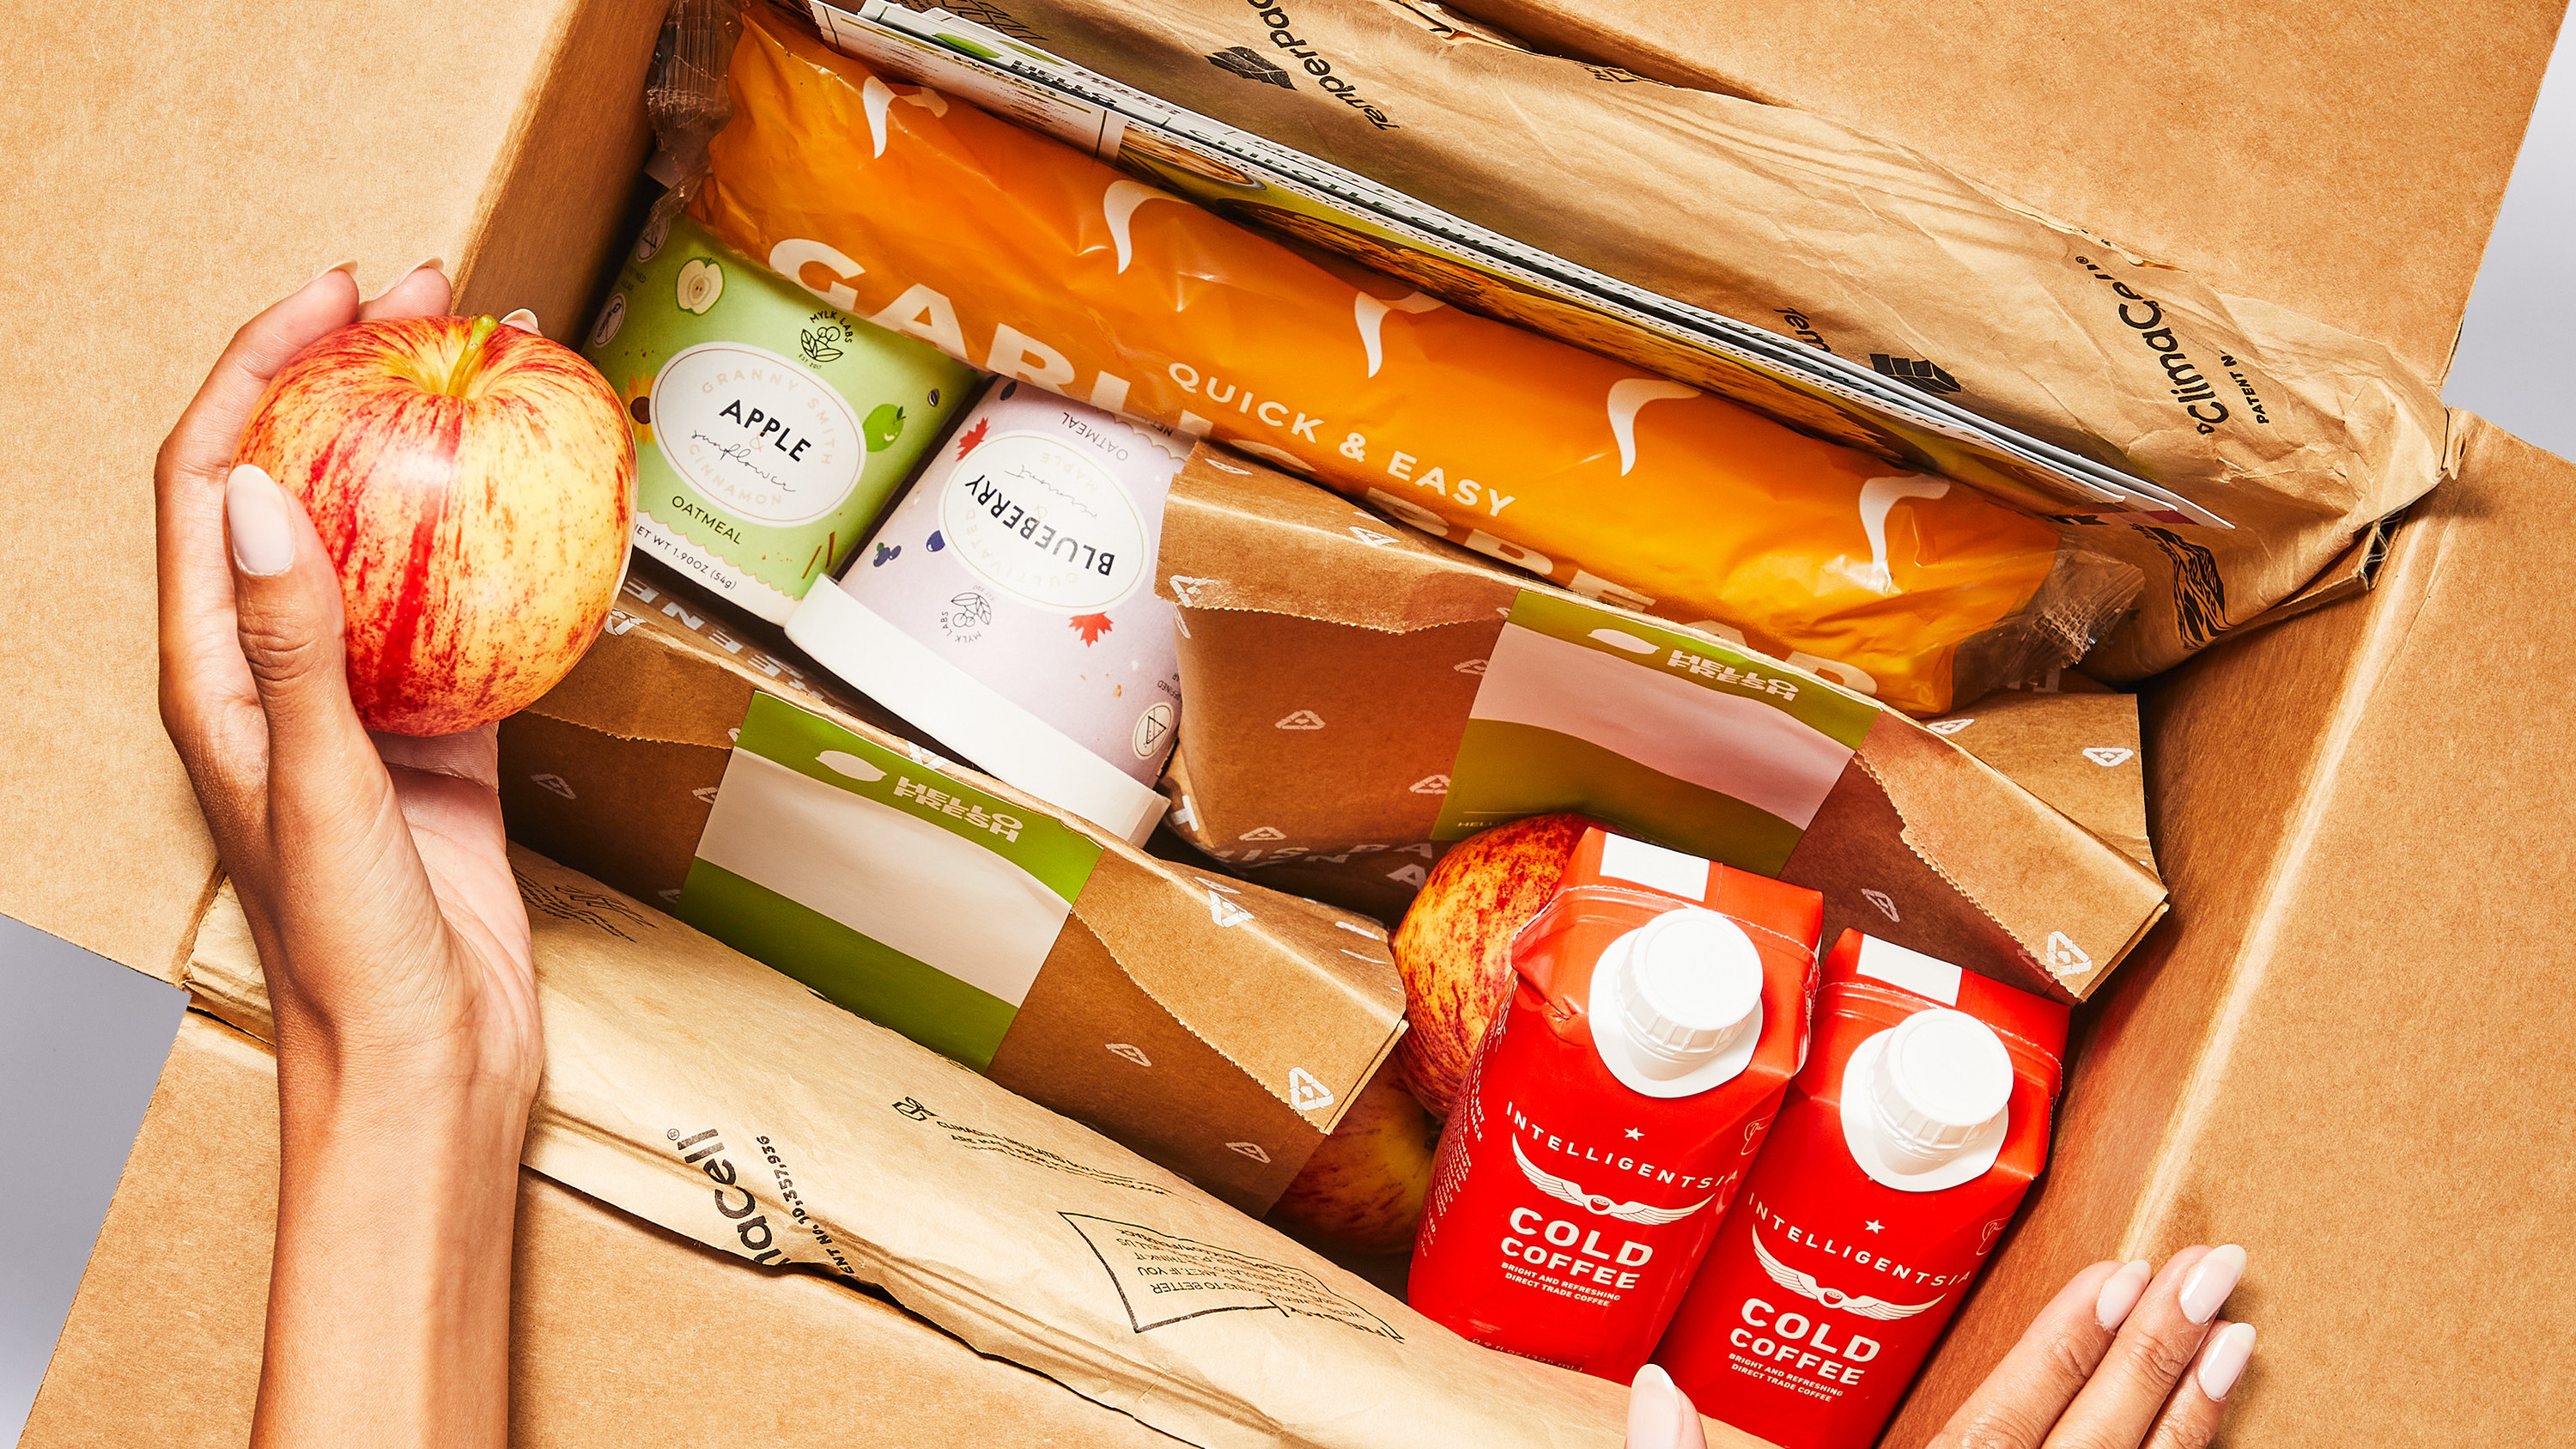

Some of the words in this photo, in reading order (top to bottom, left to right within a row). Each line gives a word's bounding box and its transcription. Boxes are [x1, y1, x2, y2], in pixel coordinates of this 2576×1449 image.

[1010, 58, 1118, 106] HELLO
[1189, 128, 1395, 212] CHIPOTLE
[1409, 213, 1600, 290] CHICKEN
[1253, 139, 1361, 183] MISO
[1375, 187, 1517, 249] PEACH
[1127, 120, 1394, 226] MEATLOAVES
[1407, 228, 1512, 269] WITH
[1706, 338, 1947, 429] MUSHROOM
[809, 310, 837, 324] MYLK
[839, 313, 854, 344] LABS
[702, 368, 799, 395] GRANNY
[806, 397, 832, 466] SMITH
[2233, 371, 2269, 426] PATENT
[719, 399, 812, 464] APPLE
[748, 429, 765, 452] &
[1061, 411, 1129, 462] OATMEAL
[1168, 362, 1326, 446] QUICK
[1337, 432, 1370, 465] &
[1386, 450, 1517, 521] EASY
[688, 442, 782, 506] CINNAMON
[690, 429, 796, 493] sunflower
[1040, 451, 1098, 496] MAPLE
[671, 495, 742, 545] OATMEAL
[964, 474, 1116, 577] BLUEBERRY
[966, 509, 1079, 585] CULTIVATED
[653, 533, 671, 551] WT
[710, 568, 738, 591] (54g)
[940, 610, 953, 638] LABS
[954, 630, 983, 643] MYLK
[1667, 657, 1796, 702] FRESH
[1671, 649, 1800, 695] HELLO
[893, 786, 1020, 843] FRESH
[897, 776, 1024, 830] HELLO
[1506, 1101, 1738, 1189] INTELLIGENTSIA
[1501, 1236, 1641, 1289] COFFEE
[1510, 1206, 1654, 1268] COLD
[1749, 1192, 1971, 1286] INTELLIGENTSIA
[1137, 1267, 1169, 1276] YOU
[1151, 1282, 1203, 1294] BETTER
[1204, 1282, 1225, 1291] TO
[1501, 1262, 1537, 1279] BRIGHT
[1538, 1272, 1559, 1285] AND
[1561, 1277, 1621, 1302] REFRESHING
[1504, 1272, 1540, 1289] DIRECT
[1541, 1282, 1572, 1298] TRADE
[1574, 1291, 1611, 1307] COFFEE
[1730, 1328, 1865, 1386] COFFEE
[1741, 1298, 1880, 1362] COLD
[1728, 1353, 1763, 1370] BRIGHT
[1765, 1366, 1784, 1377] AND
[1786, 1373, 1844, 1397] REFRESHING
[1731, 1363, 1765, 1380] DIRECT
[1767, 1375, 1796, 1391] TRADE
[1797, 1385, 1832, 1403] COFFEE
